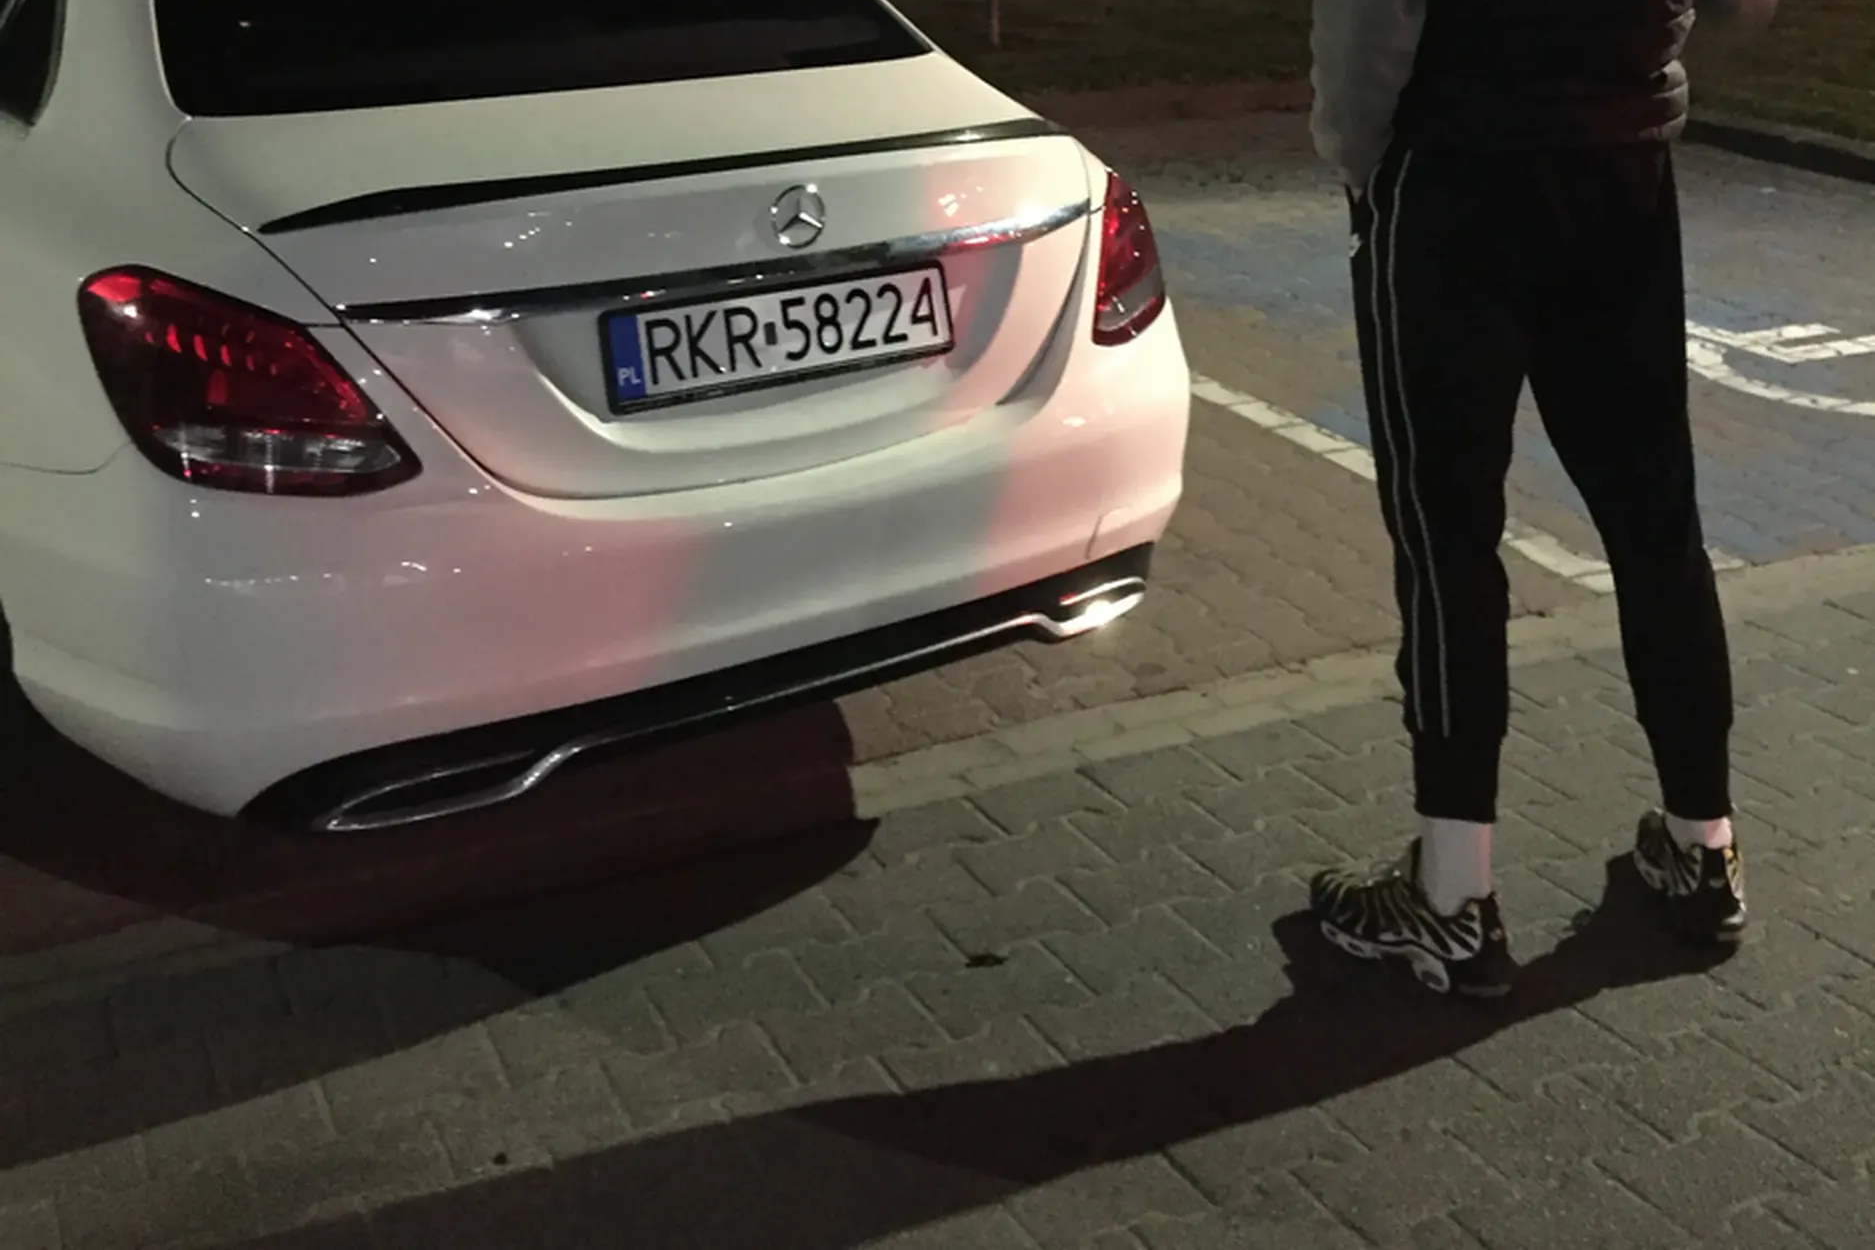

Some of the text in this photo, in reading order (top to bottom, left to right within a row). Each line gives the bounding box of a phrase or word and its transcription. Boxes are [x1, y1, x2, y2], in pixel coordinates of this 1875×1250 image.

[645, 277, 939, 385] RKR 58224
[617, 369, 641, 387] PL
